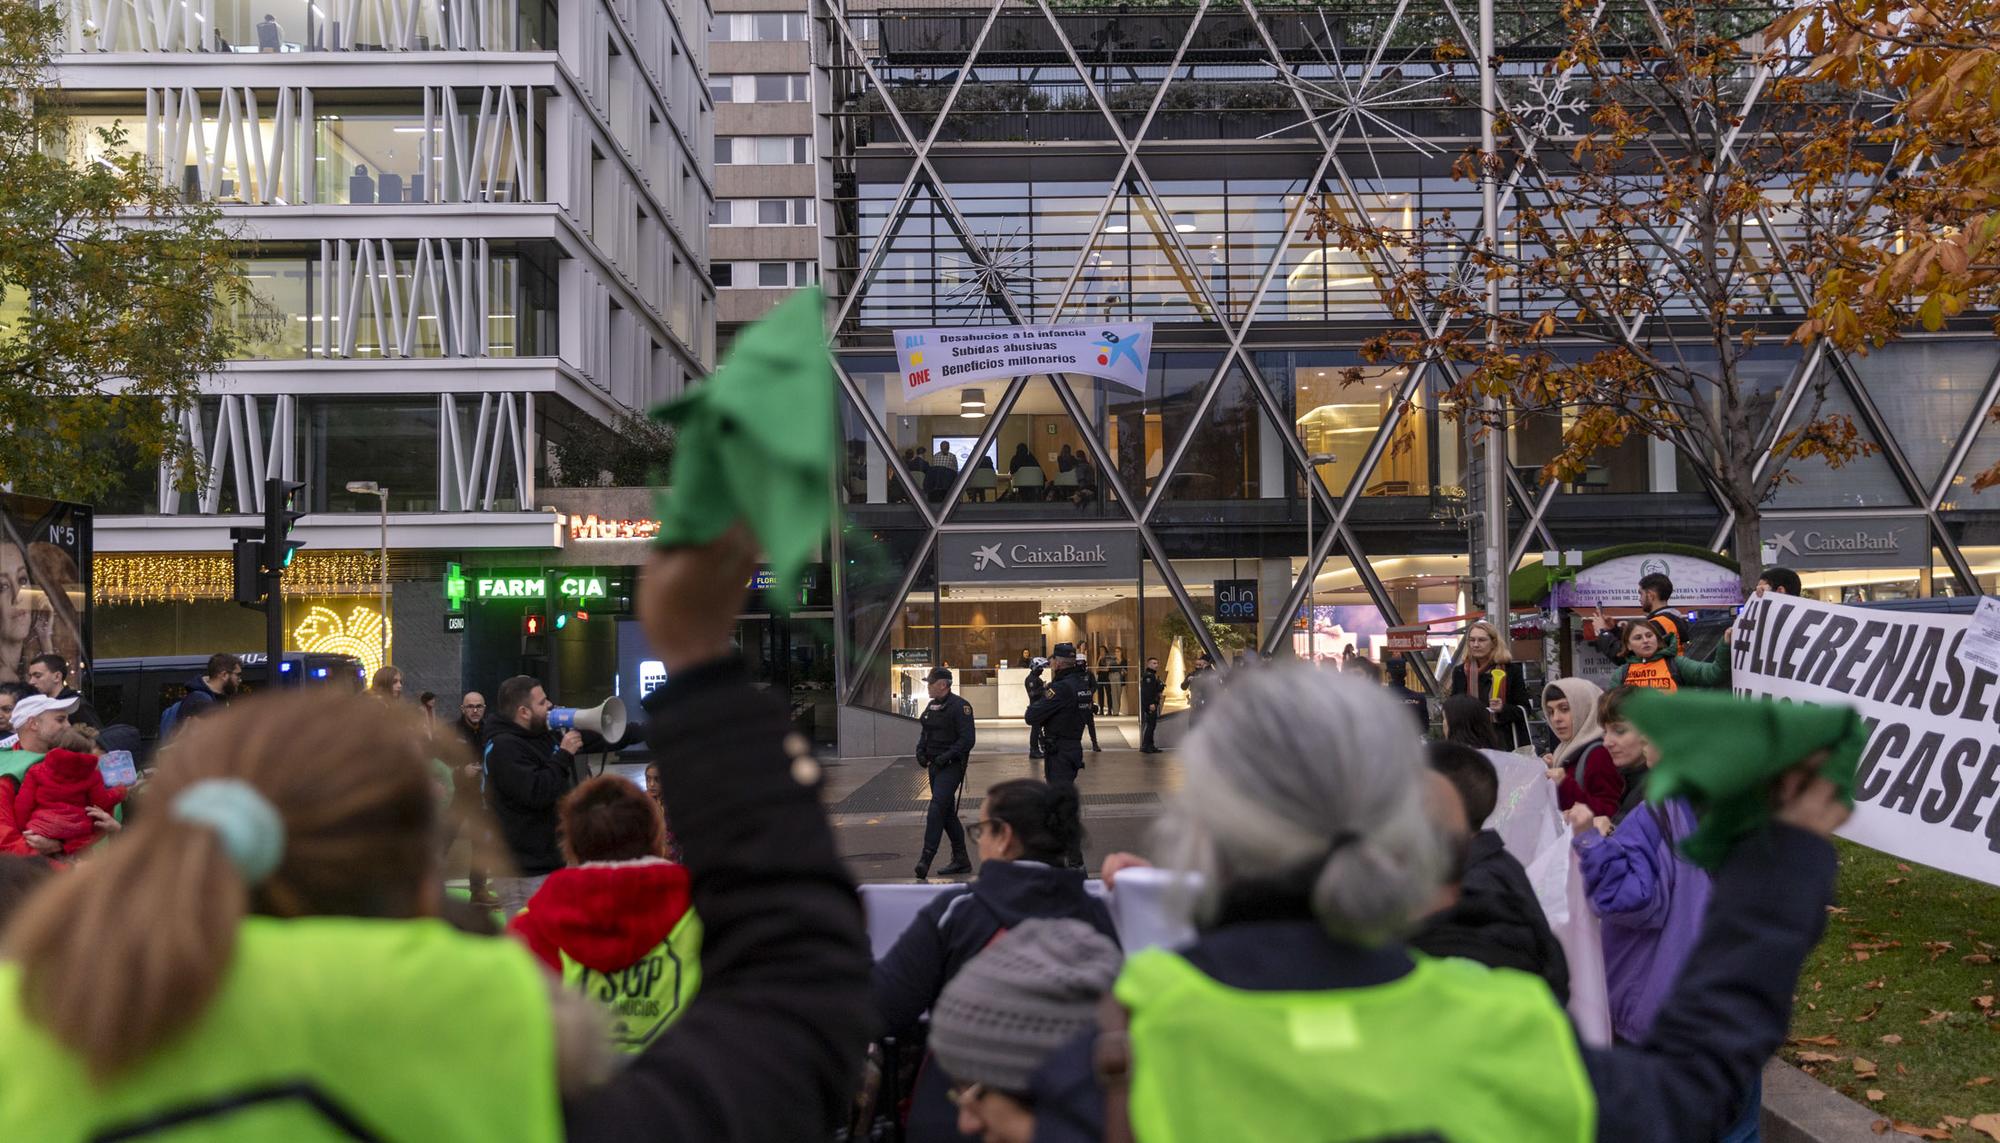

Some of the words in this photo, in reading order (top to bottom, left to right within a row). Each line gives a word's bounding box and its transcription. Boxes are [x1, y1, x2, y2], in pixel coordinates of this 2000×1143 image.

[906, 335, 925, 348] ALL
[940, 332, 1008, 343] Desahucios
[1023, 331, 1035, 339] la
[1038, 329, 1086, 338] infancia
[952, 344, 999, 357] Subidas
[1003, 342, 1057, 352] abusivas
[942, 358, 1004, 376] Beneficios
[1008, 354, 1077, 366] millonarios
[909, 369, 930, 387] ONE
[571, 513, 661, 539] Muse
[1804, 531, 1899, 550] CaixaBank
[1011, 544, 1107, 562] CaixaBank
[478, 578, 604, 596] FARMCIA
[1220, 586, 1235, 601] all
[1240, 588, 1254, 601] in
[1220, 602, 1254, 614] one
[1734, 599, 2000, 733] #LLERENASE
